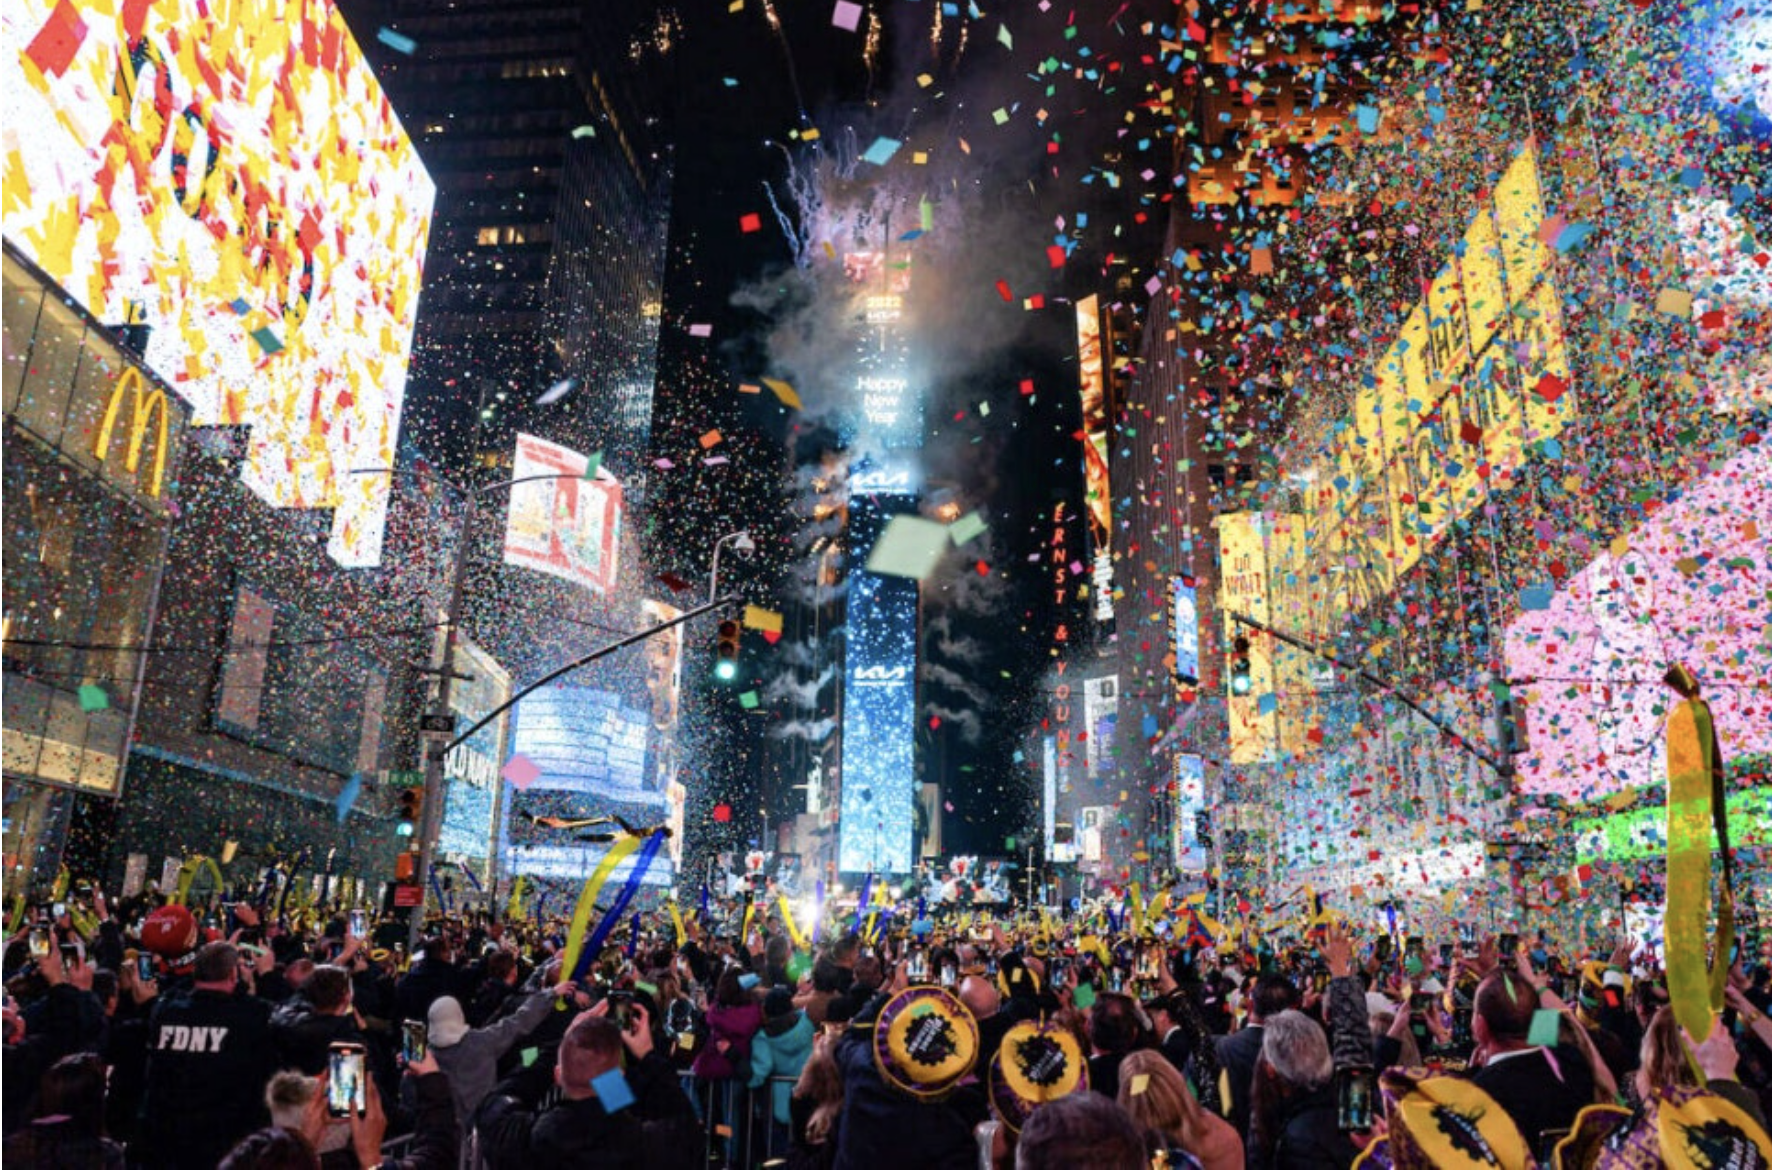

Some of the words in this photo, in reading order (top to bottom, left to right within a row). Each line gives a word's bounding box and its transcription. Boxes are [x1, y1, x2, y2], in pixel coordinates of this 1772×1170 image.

[855, 377, 907, 394] Happy
[864, 394, 899, 408] New
[866, 409, 899, 425] Year
[1052, 502, 1067, 605] ERNST
[1054, 625, 1069, 641] &
[853, 665, 906, 679] KIA
[1056, 662, 1070, 767] YOUNG
[158, 1024, 228, 1052] FDNY
